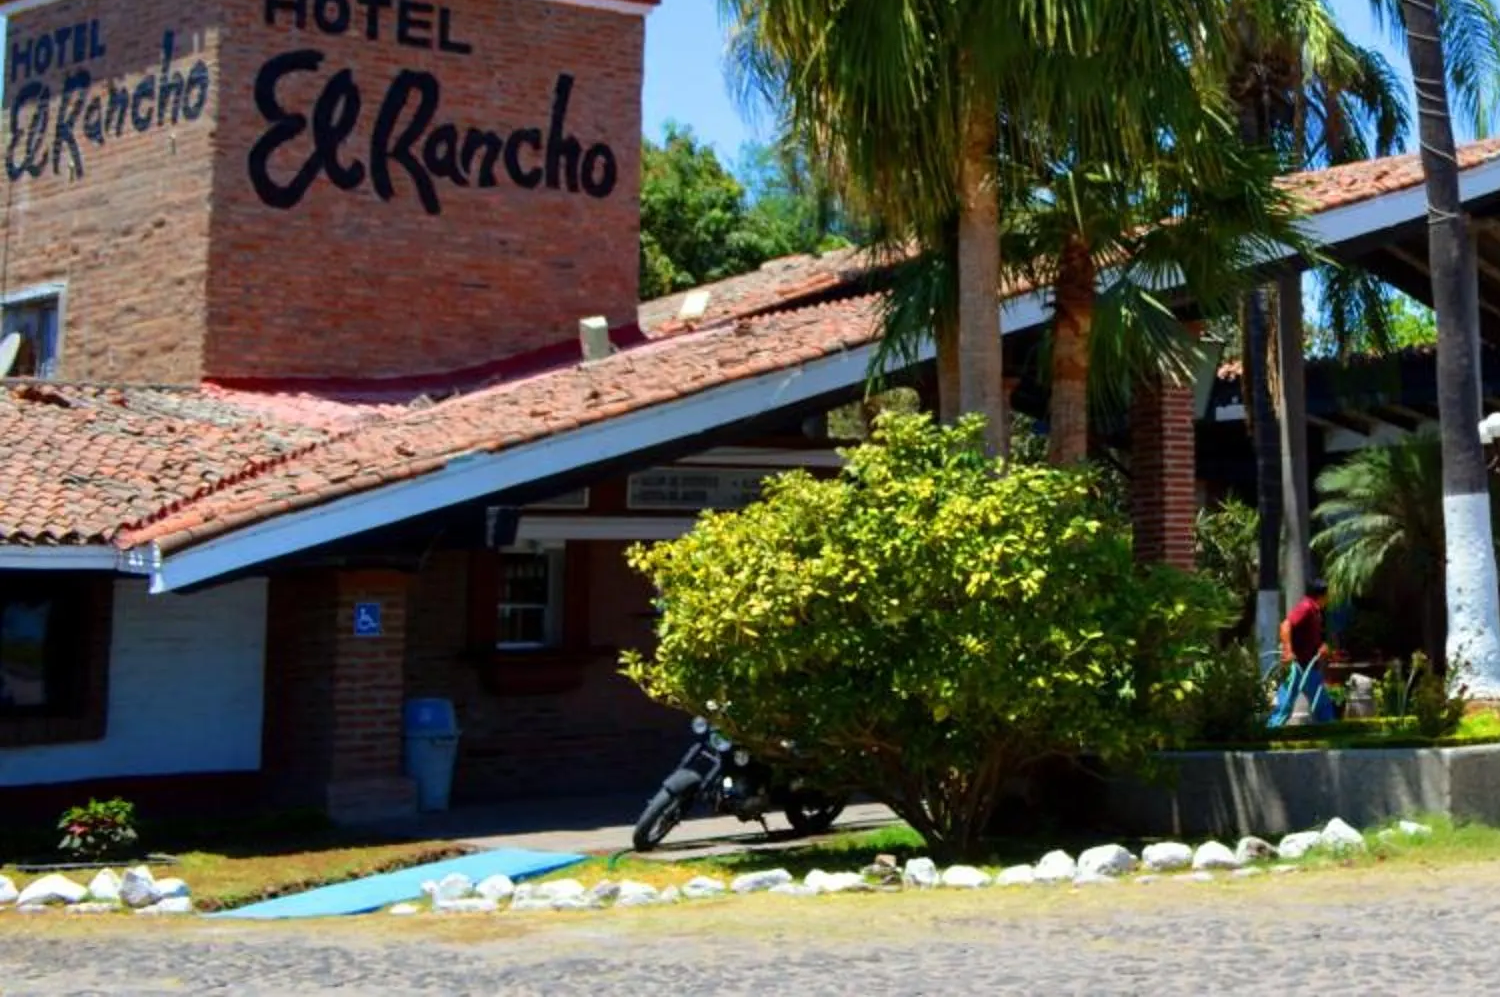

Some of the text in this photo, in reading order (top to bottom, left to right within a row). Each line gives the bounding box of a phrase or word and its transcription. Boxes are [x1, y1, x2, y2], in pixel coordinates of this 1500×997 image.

[11, 19, 106, 83] HOTEL
[53, 30, 208, 179] Rancho
[249, 49, 617, 215] El Rancho
